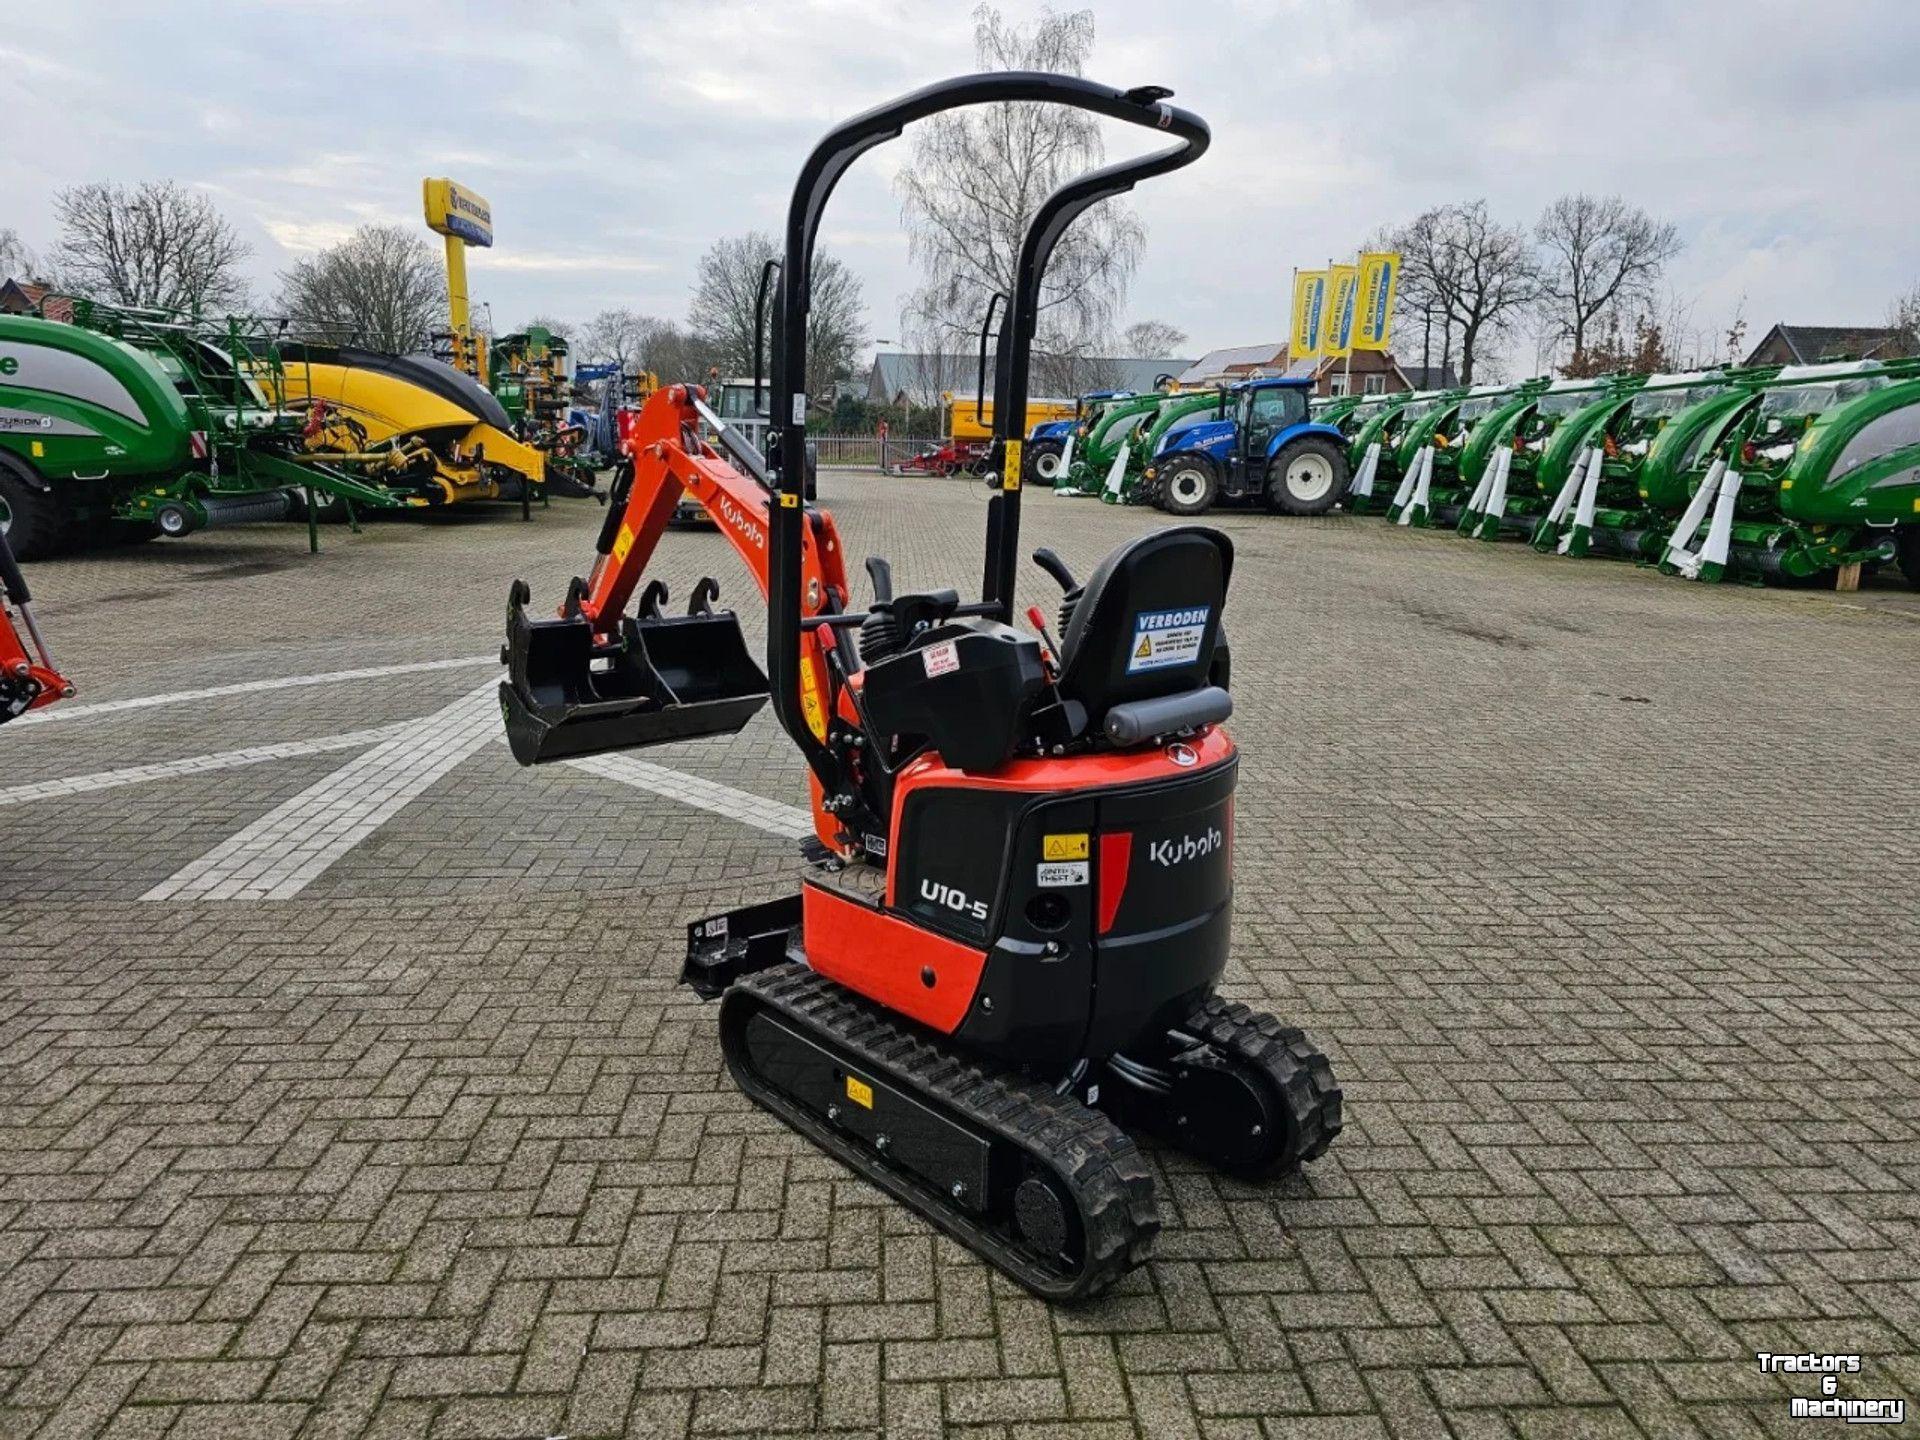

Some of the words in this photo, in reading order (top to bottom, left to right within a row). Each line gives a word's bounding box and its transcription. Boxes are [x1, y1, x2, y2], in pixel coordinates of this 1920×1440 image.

[720, 495, 764, 549] Kubota
[1140, 609, 1208, 630] VERBODEN
[1150, 827, 1222, 867] Kubota
[920, 878, 989, 920] U10-5
